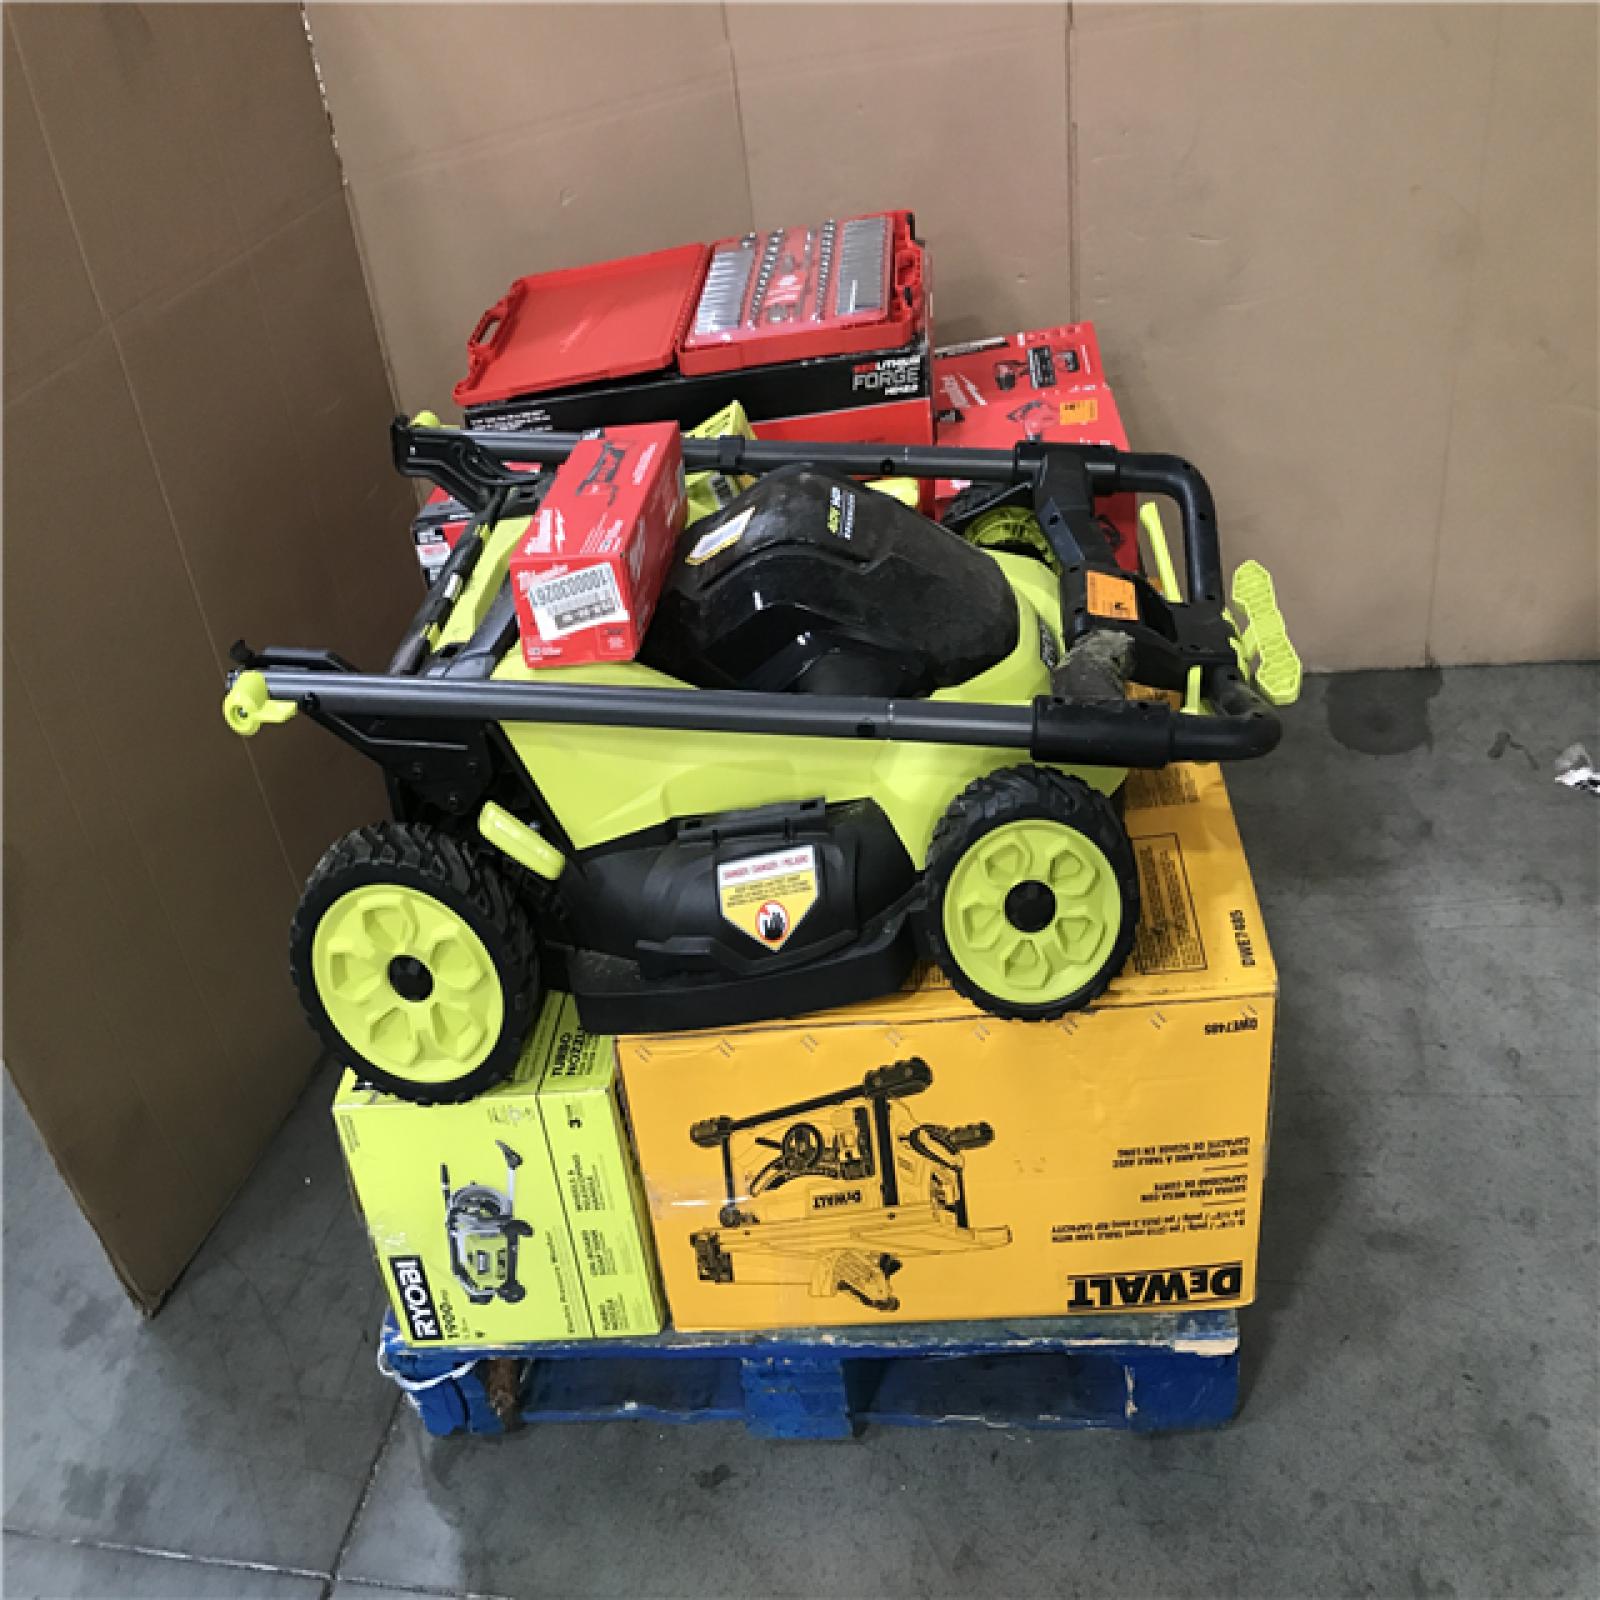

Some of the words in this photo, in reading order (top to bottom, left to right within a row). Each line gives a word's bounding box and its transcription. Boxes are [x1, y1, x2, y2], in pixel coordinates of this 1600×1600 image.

[852, 369, 919, 390] FORGE
[566, 1027, 586, 1076] NOZZL
[396, 1260, 438, 1337] RYOBI
[1068, 1268, 1241, 1306] DEWALT
[439, 1304, 460, 1340] 1900
